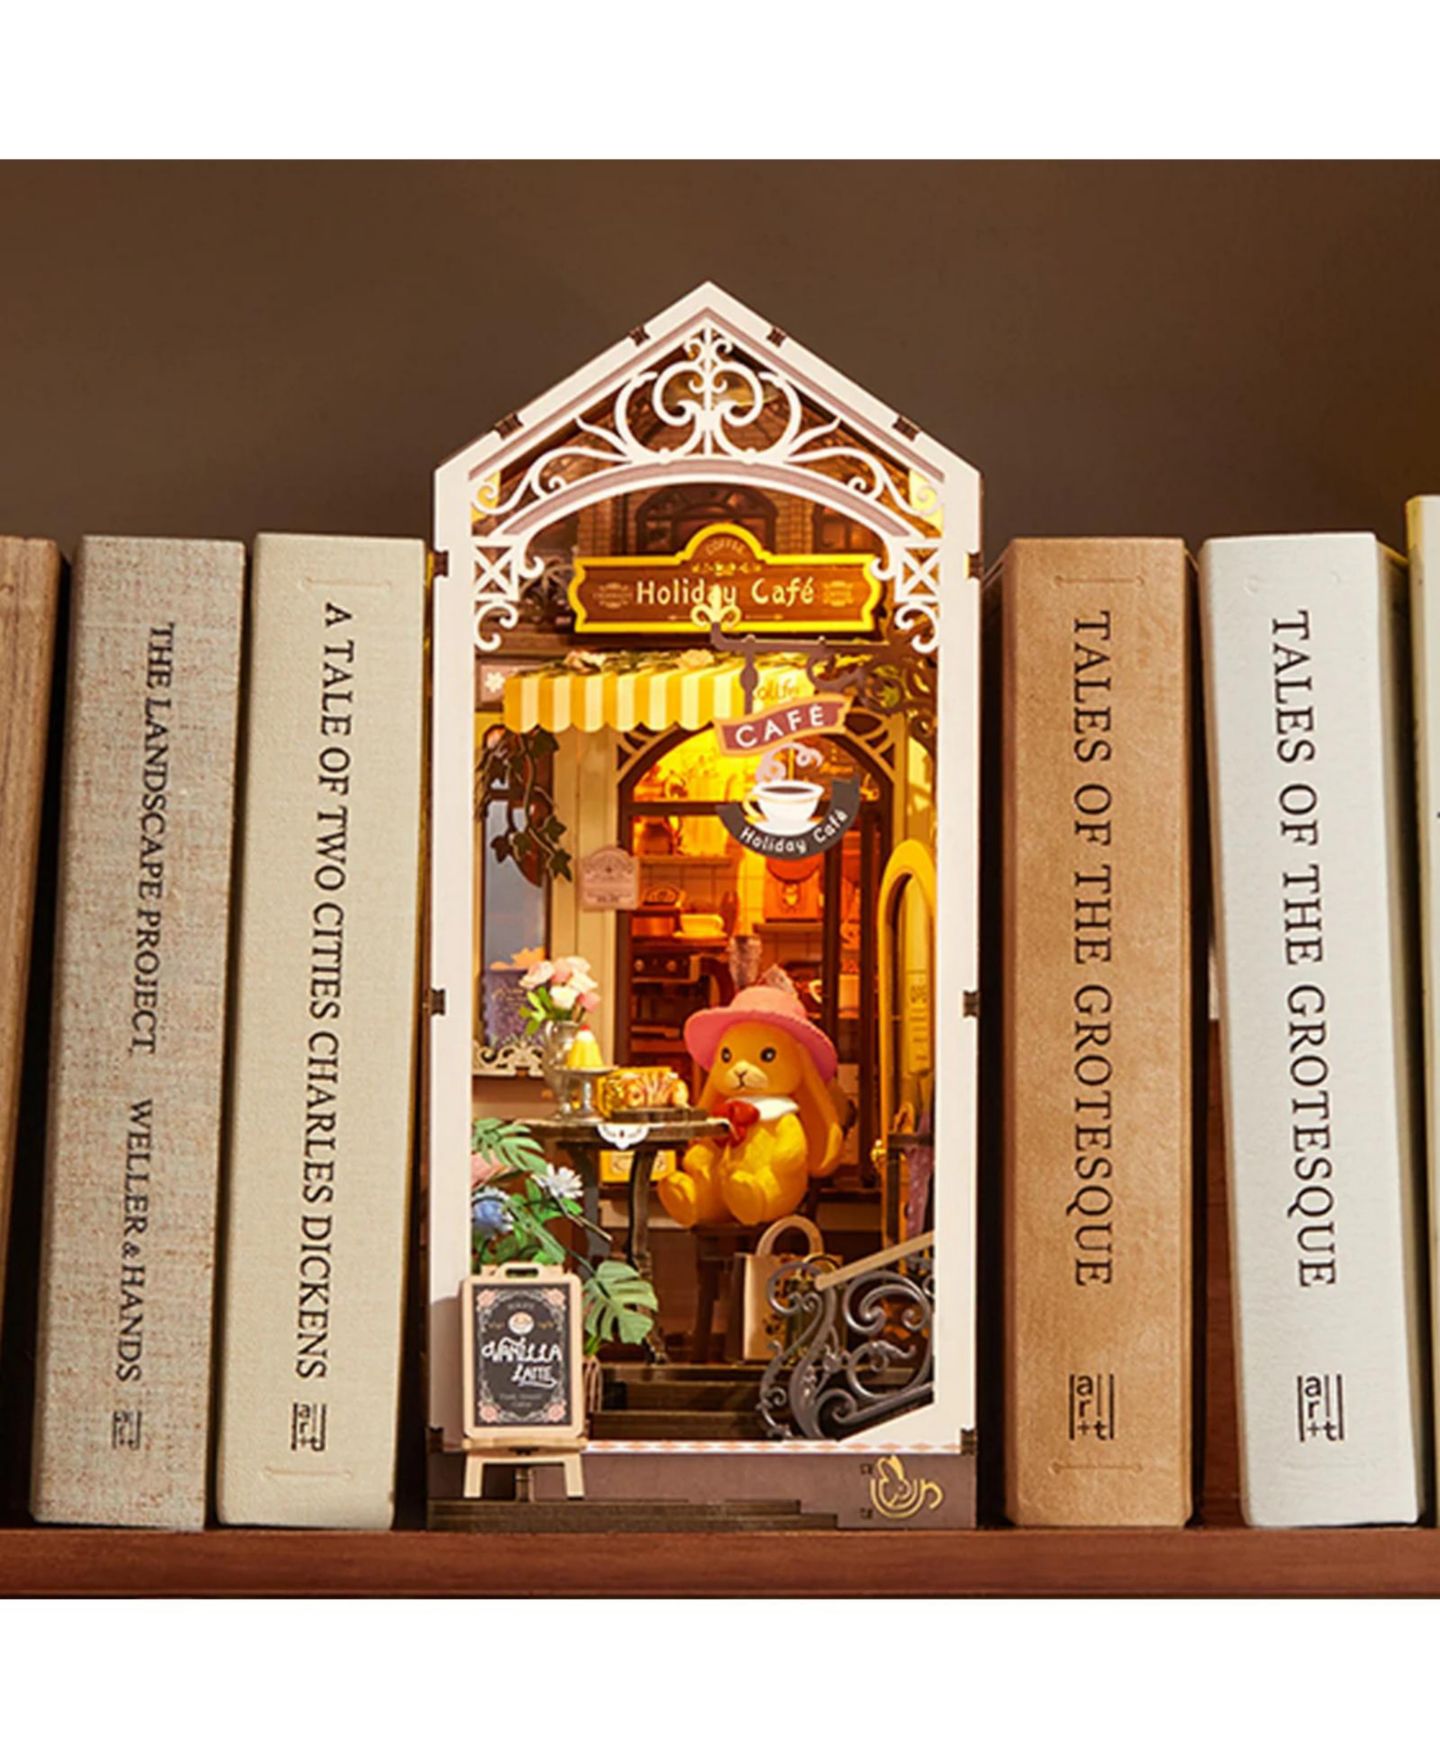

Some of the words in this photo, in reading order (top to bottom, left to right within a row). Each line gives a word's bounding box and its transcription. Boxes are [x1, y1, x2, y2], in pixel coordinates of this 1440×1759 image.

[324, 602, 353, 627] A
[636, 577, 738, 608] Holidy
[750, 576, 815, 606] Café
[146, 621, 175, 689] THE
[321, 639, 355, 736] TALE
[1073, 610, 1112, 763] TALES
[1272, 609, 1316, 764] TALES
[318, 746, 351, 796] OF
[735, 703, 824, 747] CAFÉ
[139, 696, 172, 900] LANDSCAPE
[314, 805, 349, 892] TWO
[740, 826, 808, 853] Holiday
[813, 808, 848, 843] Café
[1073, 783, 1112, 847] OF
[1278, 783, 1318, 846] OF
[309, 901, 345, 1020] CITIES
[1073, 863, 1112, 965] THE
[1282, 863, 1323, 965] THE
[131, 908, 162, 1055] PROJECT
[122, 1098, 152, 1233] WELLER
[302, 1030, 340, 1203] CHARLES
[1066, 984, 1113, 1287] GROTESQUE
[1286, 984, 1336, 1287] GROTESQUE
[121, 1240, 141, 1260] &
[295, 1215, 333, 1379] DICKENS
[115, 1264, 146, 1383] HANDS
